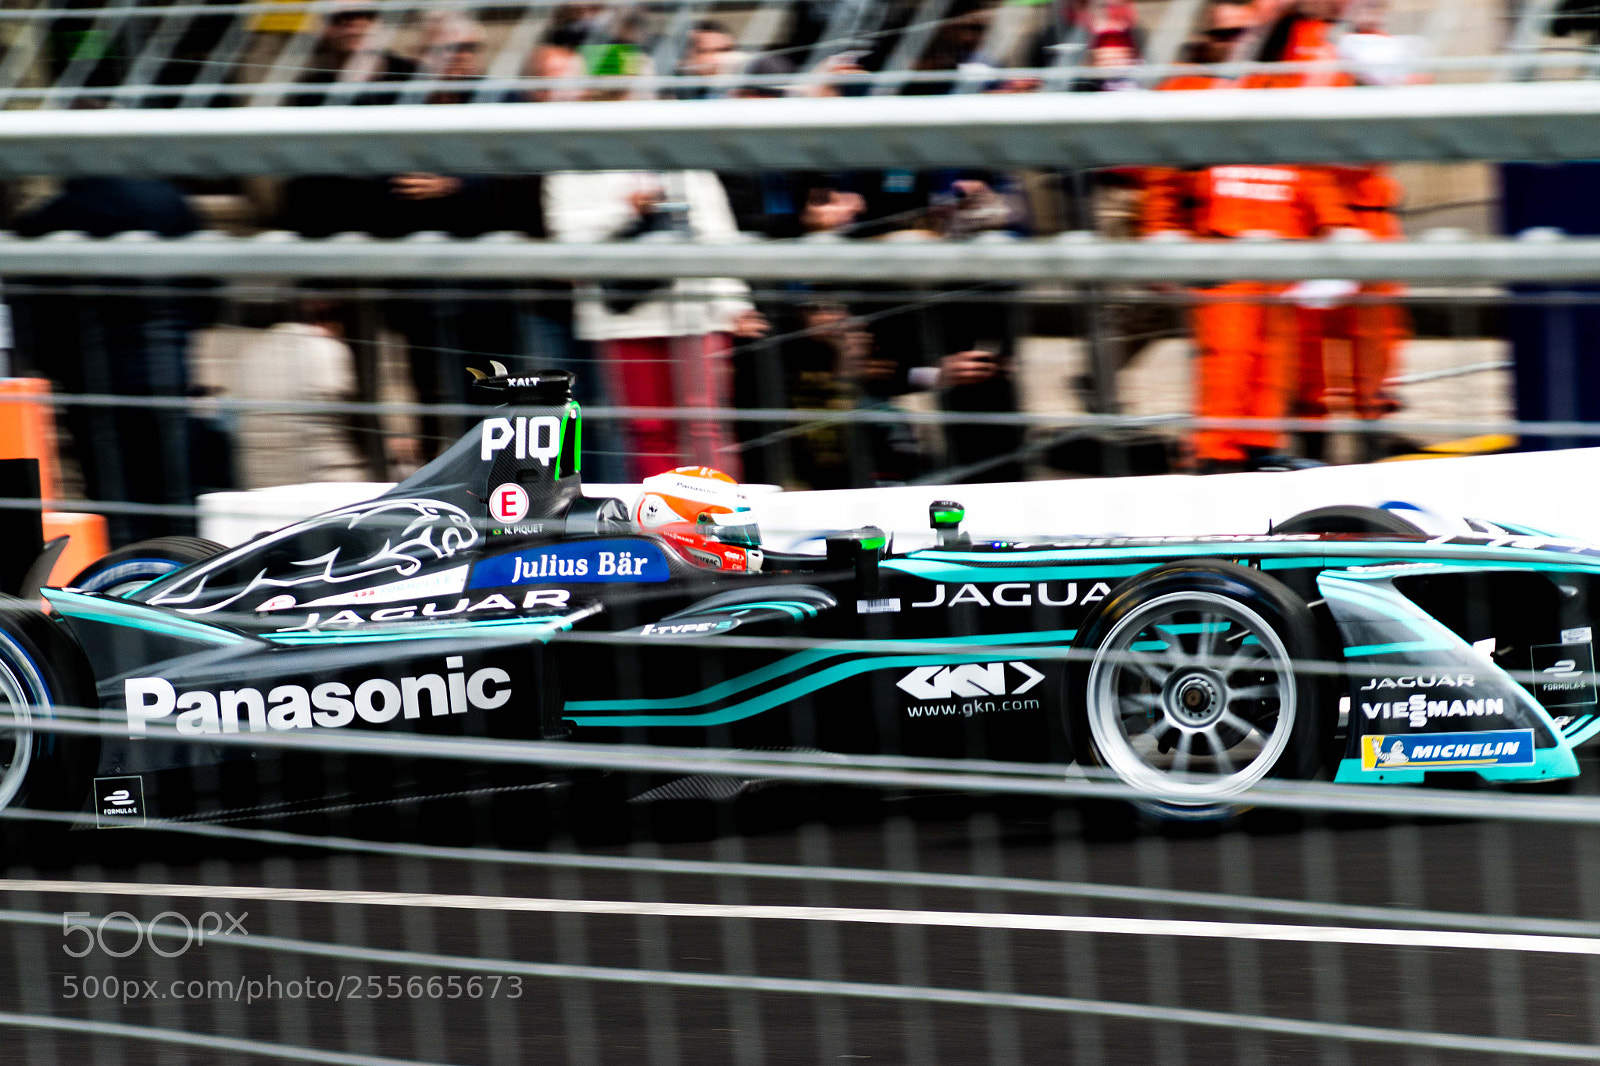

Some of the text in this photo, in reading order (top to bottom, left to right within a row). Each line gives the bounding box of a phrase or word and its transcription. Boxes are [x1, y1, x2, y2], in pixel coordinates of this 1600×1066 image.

[507, 377, 540, 387] XALT
[481, 416, 560, 466] PIQ
[501, 491, 517, 517] E
[513, 523, 544, 535] PIQUET
[512, 551, 648, 583] Julius Bär
[912, 582, 1112, 607] JAGUA
[276, 589, 571, 633] JAGUAR
[1360, 673, 1476, 691] JAGUAR
[124, 656, 512, 740] Panasonic
[907, 699, 1040, 718] www.gkn.com
[1361, 694, 1504, 728] VIESSMANN
[1411, 741, 1520, 759] MICHELIN
